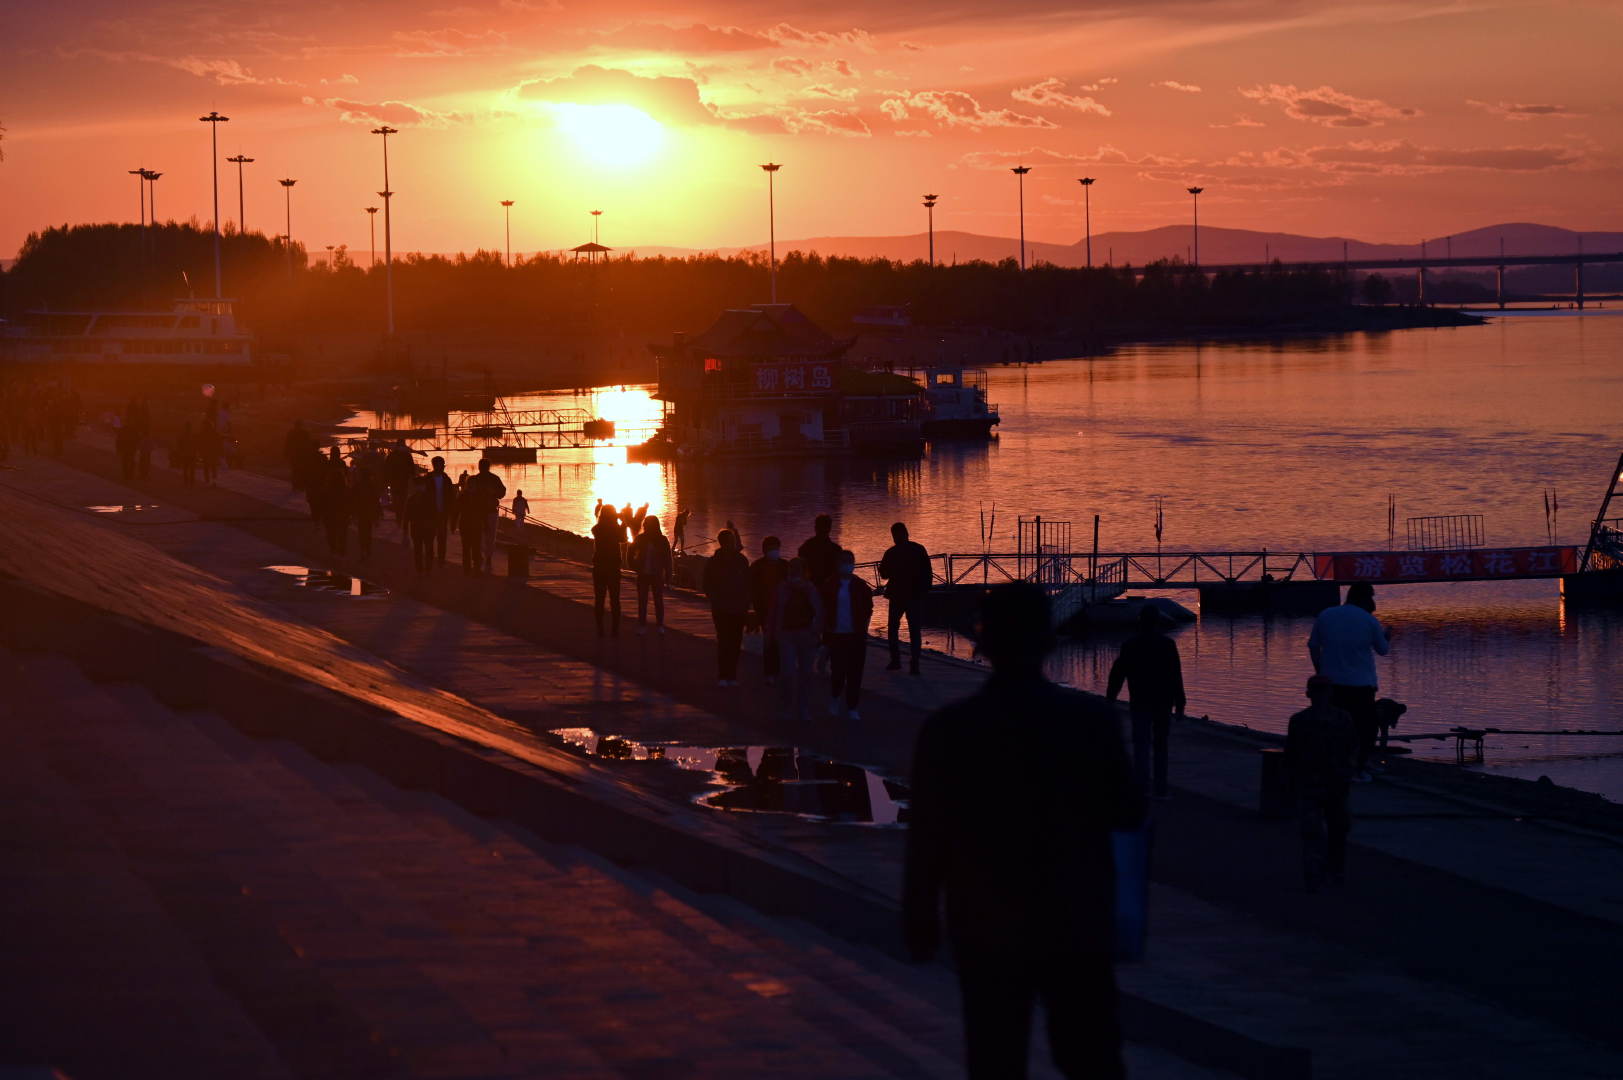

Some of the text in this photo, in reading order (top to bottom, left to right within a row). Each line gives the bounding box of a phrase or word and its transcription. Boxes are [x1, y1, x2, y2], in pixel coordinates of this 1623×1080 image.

[757, 365, 832, 390] 柳树岛
[1354, 551, 1559, 577] 游览松花江
